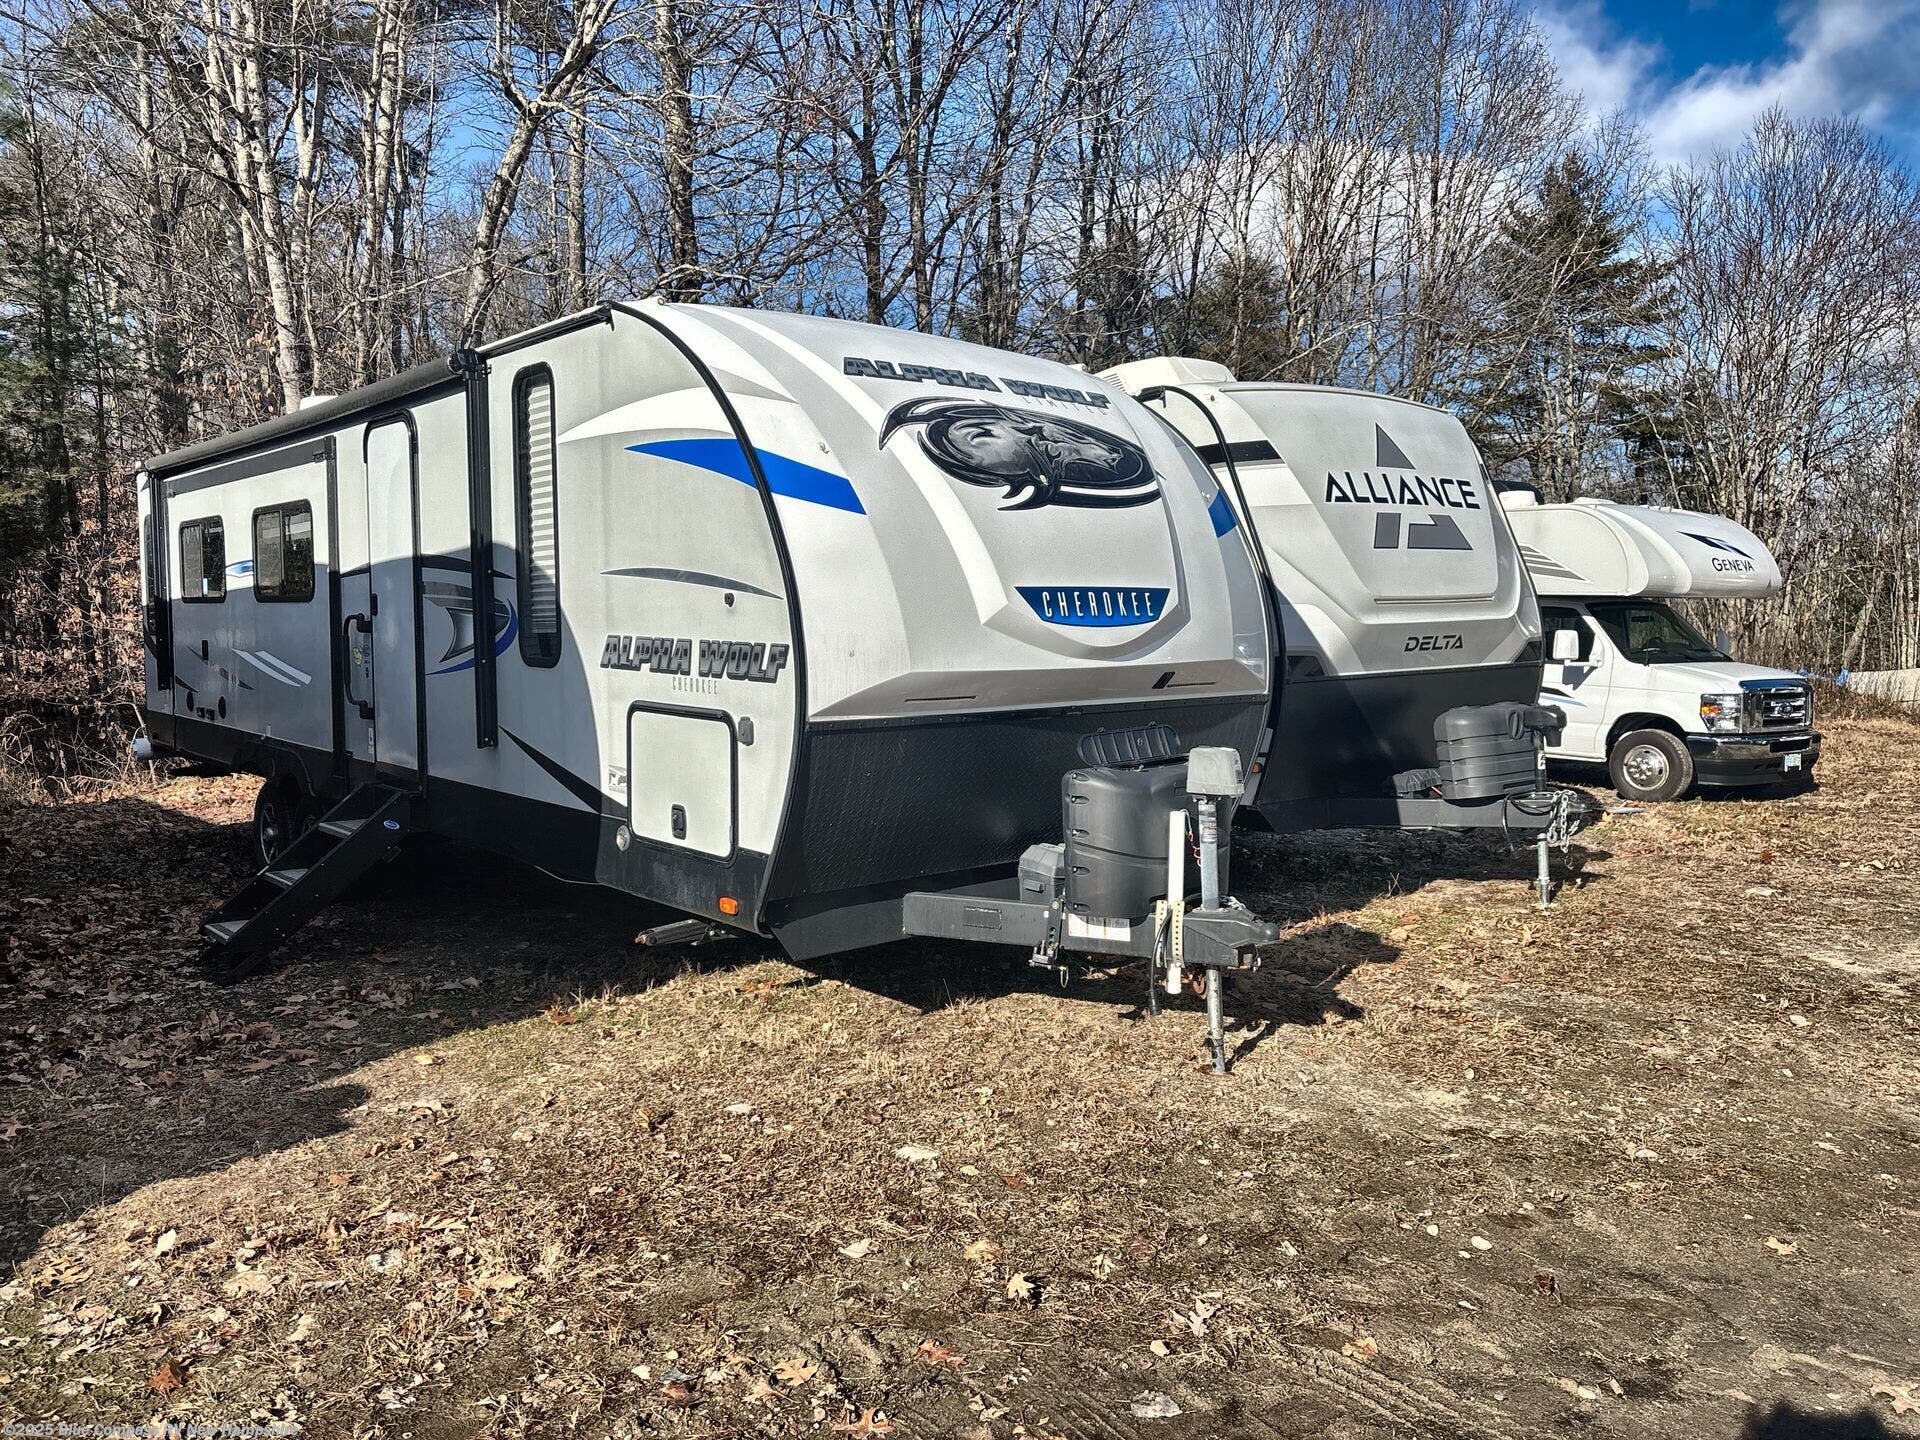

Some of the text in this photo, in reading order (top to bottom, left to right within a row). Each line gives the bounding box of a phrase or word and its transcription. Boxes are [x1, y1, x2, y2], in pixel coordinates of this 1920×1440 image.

[844, 357, 1112, 409] ALPHA WOLF
[1325, 471, 1481, 510] ALLIANCE
[1711, 557, 1755, 572] GENEVA
[1042, 591, 1155, 618] CHEROKEE
[600, 634, 790, 684] ALPHA WOLF
[1404, 634, 1464, 652] DELTA
